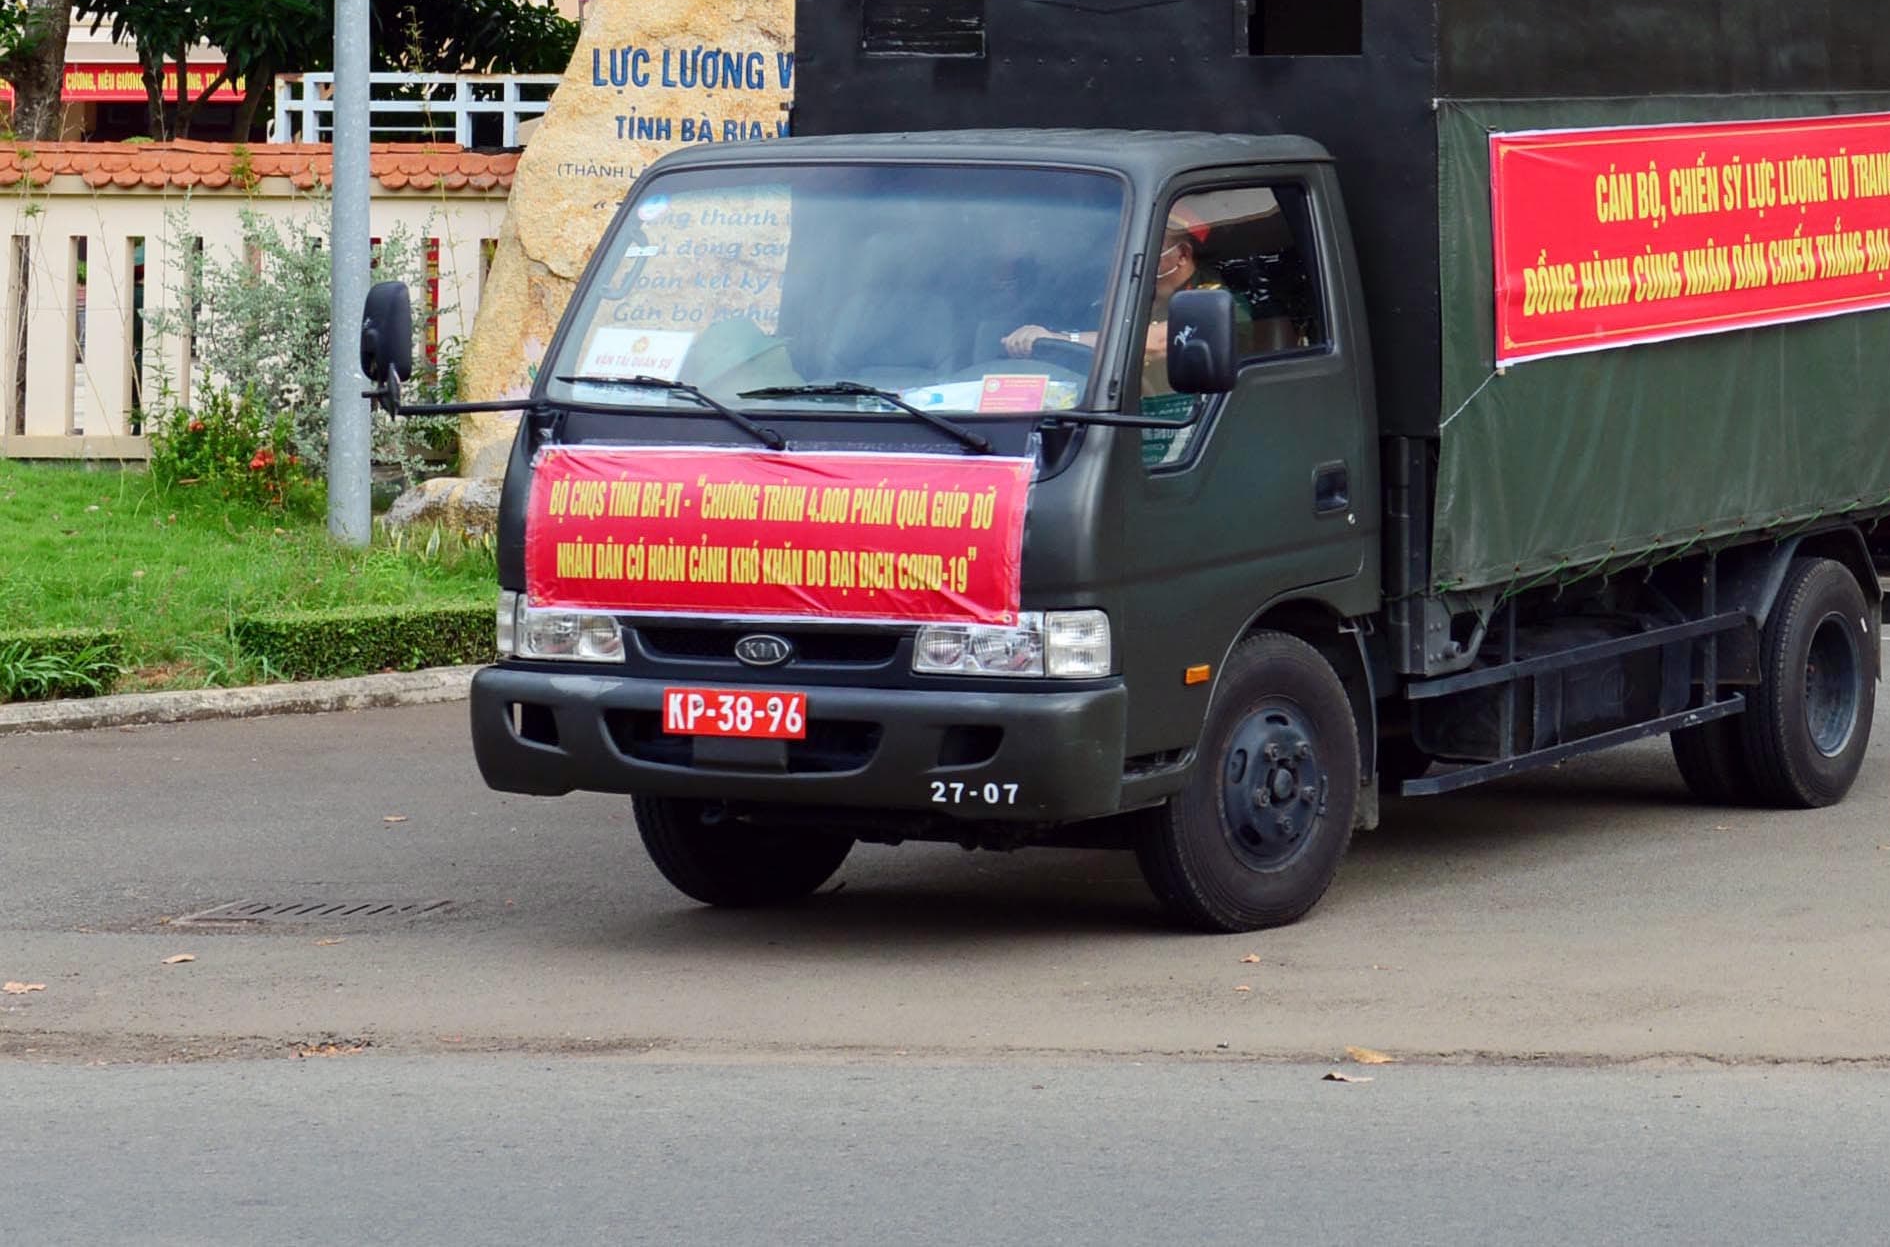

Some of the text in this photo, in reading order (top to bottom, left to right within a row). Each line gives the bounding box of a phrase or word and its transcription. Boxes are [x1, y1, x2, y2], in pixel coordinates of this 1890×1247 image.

[592, 45, 794, 98] LỰC LƯỢNG V
[615, 106, 713, 143] TỈNH BÀ
[1595, 163, 1634, 224] CÁN
[1636, 160, 1667, 229] BỘ,
[1668, 151, 1720, 217] CHIẾN
[1722, 155, 1743, 211] SỸ
[1745, 157, 1777, 218] LỰC
[1778, 154, 1828, 214] LƯỢNG
[1829, 147, 1850, 201] VŨ
[1523, 248, 1578, 317] ĐỒNG
[1579, 250, 1631, 308] HÀNH
[1633, 244, 1682, 302] CÙNG
[1683, 238, 1732, 296] NHÂN
[1732, 234, 1768, 289] DÂN
[1768, 223, 1817, 286] CHIẾN
[1816, 216, 1865, 279] THẮNG
[549, 476, 570, 523] BỘ
[570, 481, 607, 519] CHQS
[641, 482, 684, 517] BR-VT
[698, 476, 761, 520] “CHƯƠNG
[807, 487, 850, 523] 4.000
[931, 485, 970, 528] GIÚP
[971, 486, 996, 530] ĐỠ
[557, 534, 977, 595] NHÂN DÂN CÓ HOÀN CẢNH KHÓ KHĂN DO ĐẠI DỊCH COVID-19”
[744, 640, 782, 660] KIA
[668, 693, 803, 733] KP-38-96
[931, 782, 1019, 805] 27-07
